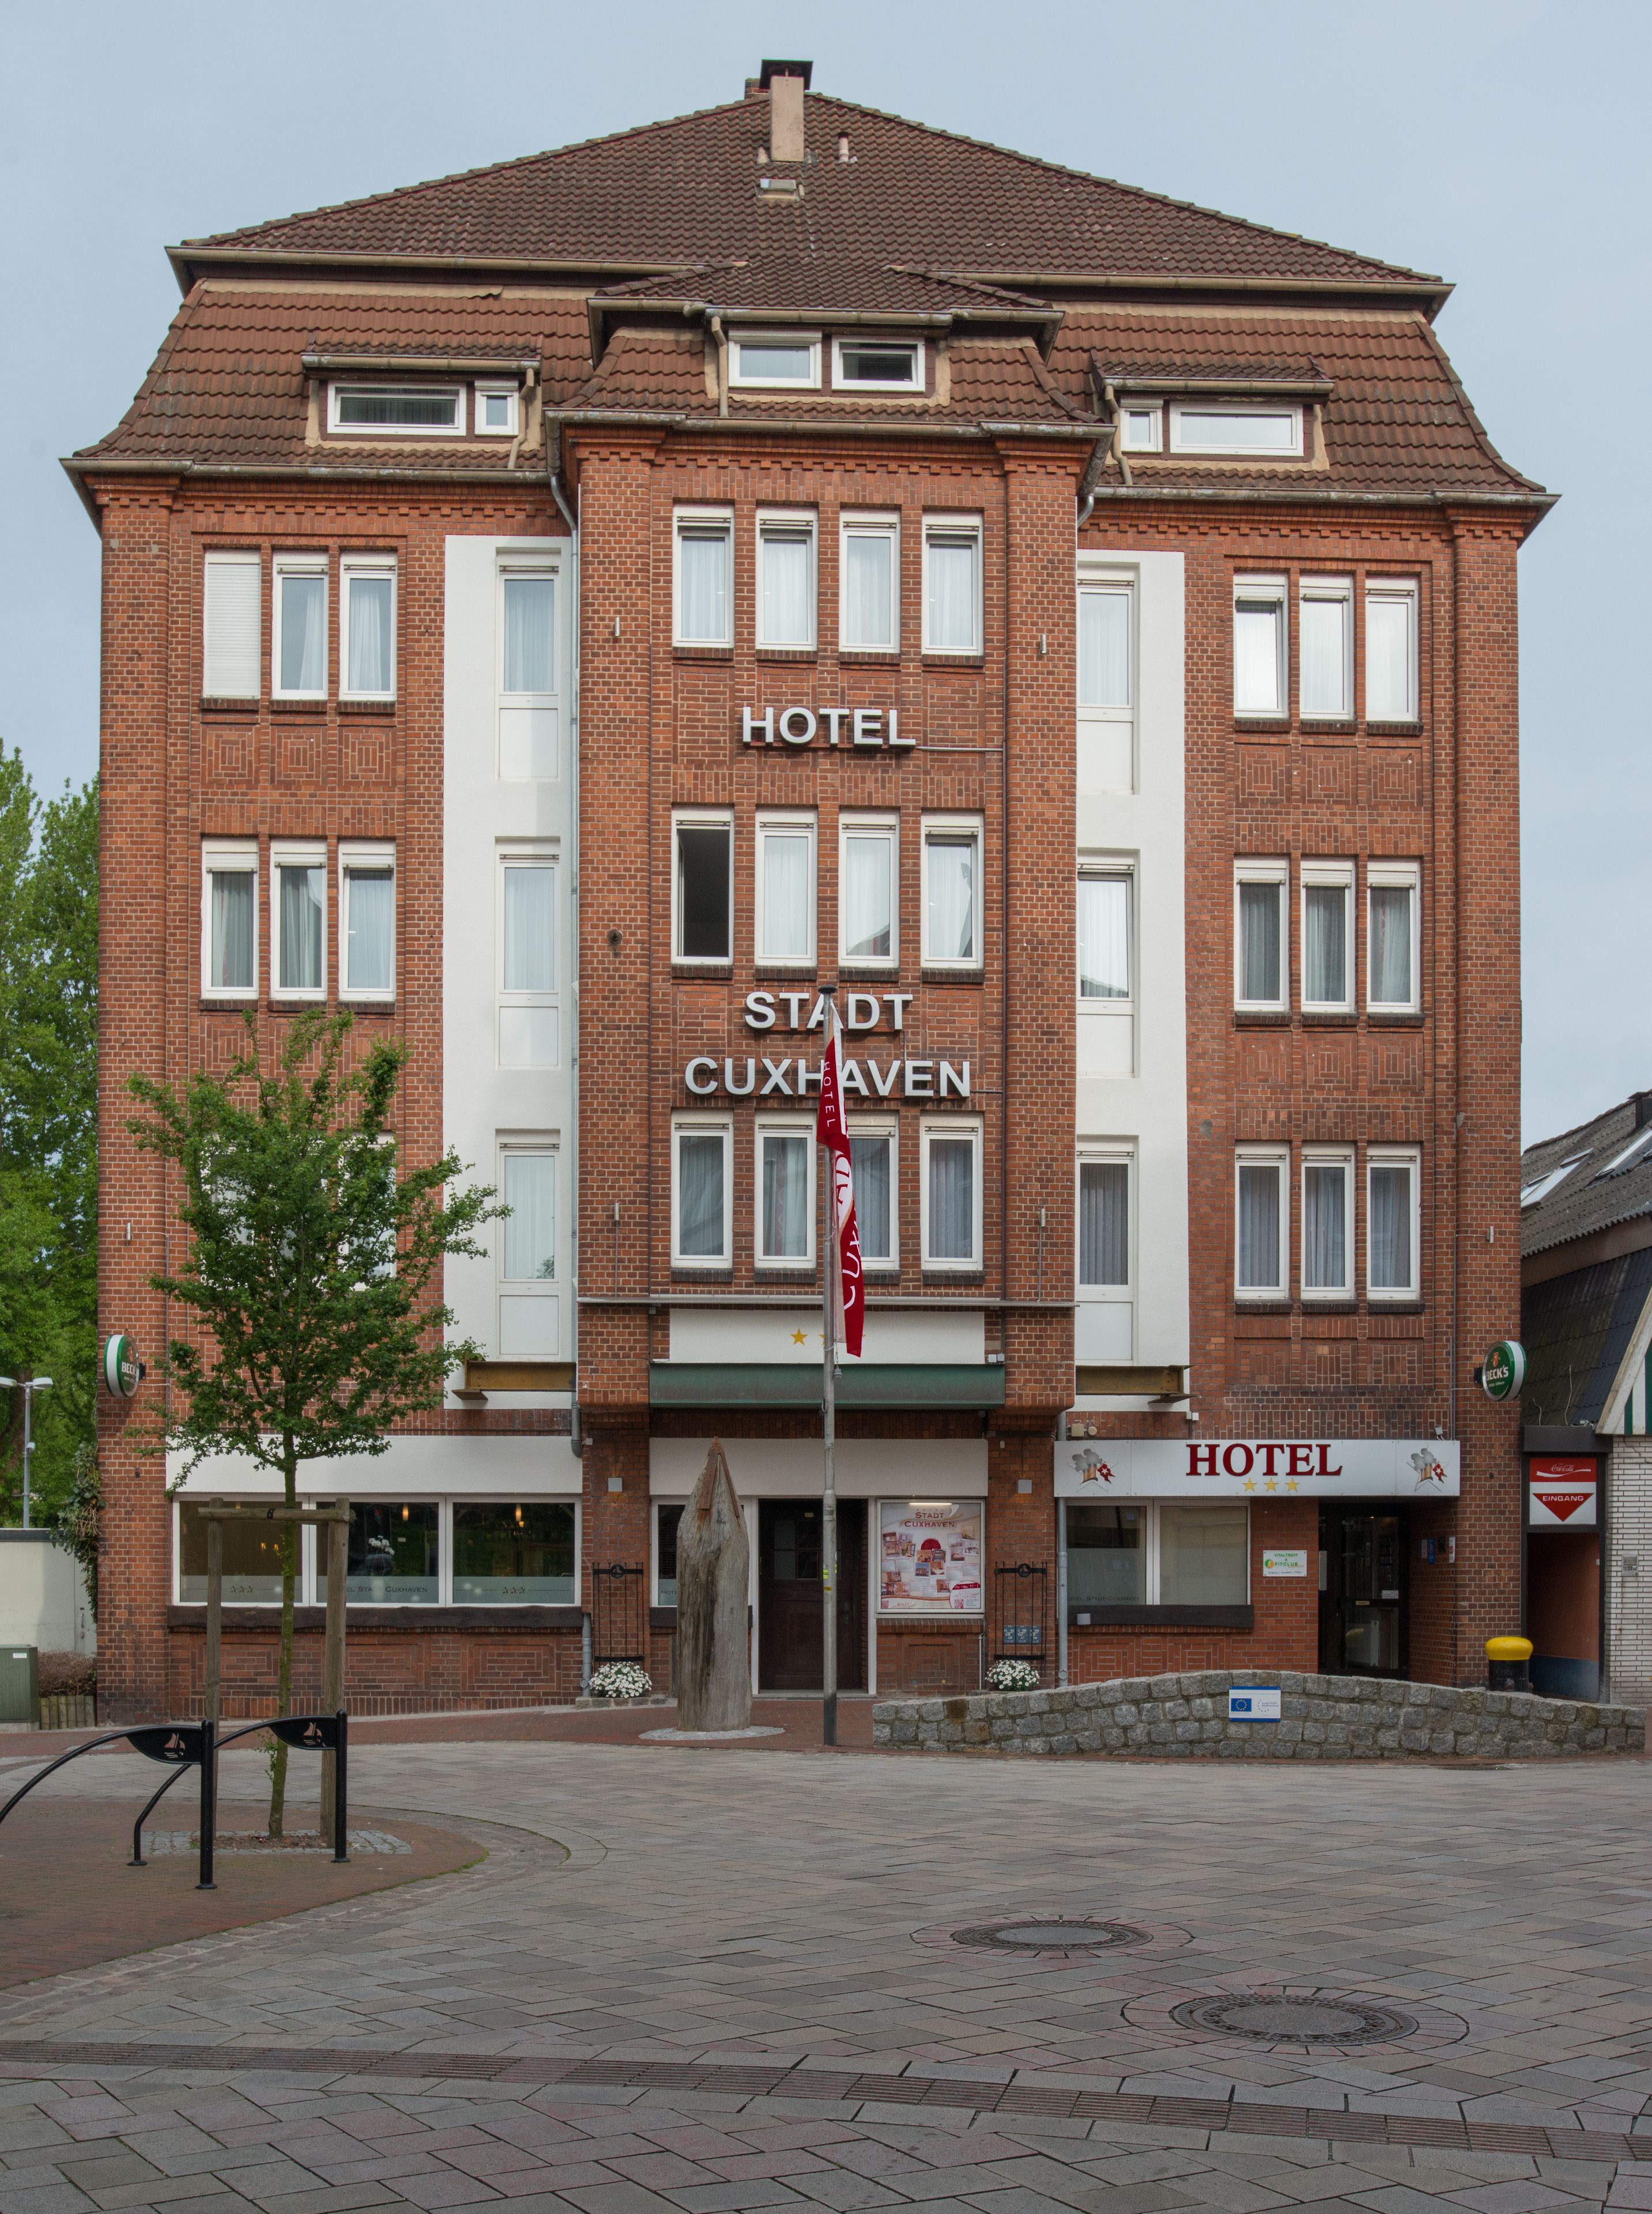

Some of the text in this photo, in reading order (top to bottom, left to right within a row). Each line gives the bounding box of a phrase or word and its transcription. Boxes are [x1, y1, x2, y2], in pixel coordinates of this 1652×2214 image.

[742, 705, 917, 747] HOTEL
[744, 991, 914, 1031] STADT
[684, 1056, 971, 1098] CUXHAVEN
[823, 1061, 836, 1128] HOTEL
[1486, 1365, 1509, 1381] BECK'S
[1185, 1443, 1343, 1477] HOTEL
